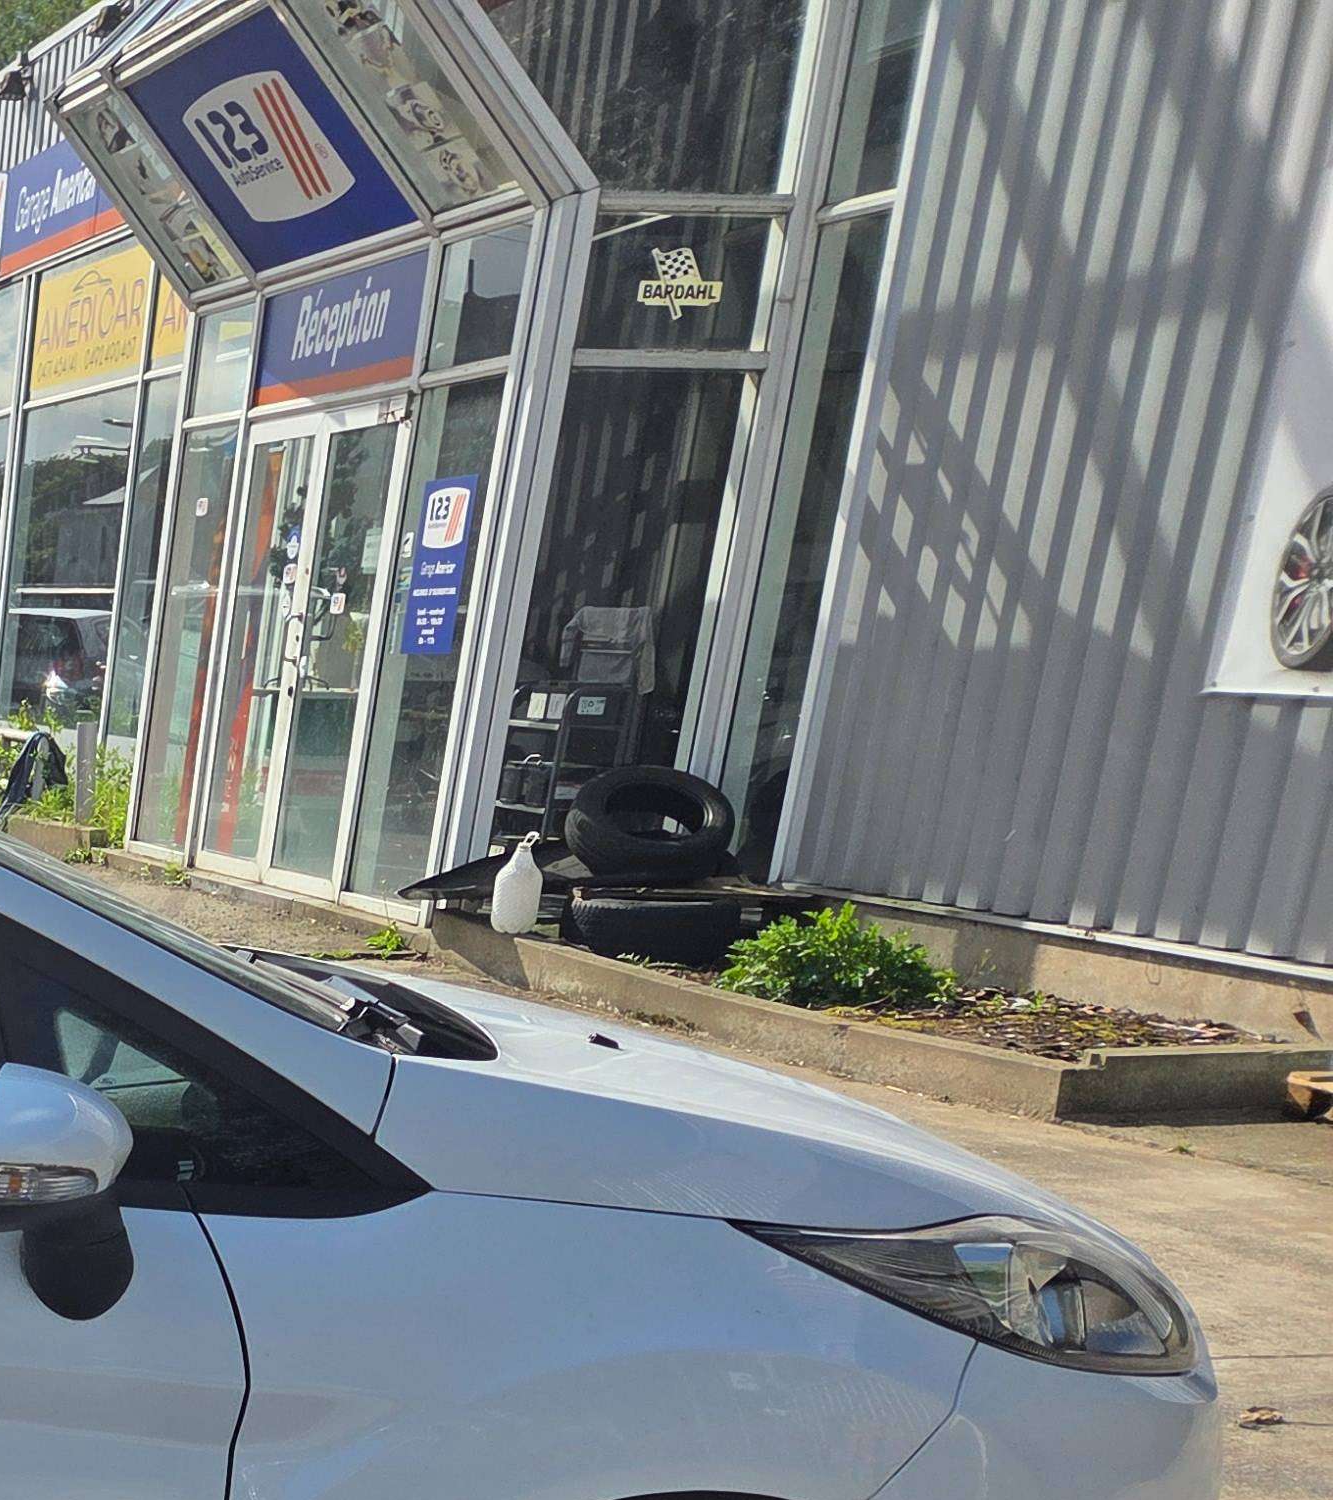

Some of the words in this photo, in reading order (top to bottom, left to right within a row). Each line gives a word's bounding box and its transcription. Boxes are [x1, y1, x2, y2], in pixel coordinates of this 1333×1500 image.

[194, 101, 269, 179] 123
[231, 157, 284, 187] AutoService
[15, 185, 51, 235] Garage
[37, 278, 146, 354] AMERICAR
[642, 284, 717, 300] BARDAHL
[291, 276, 391, 367] Réception
[429, 495, 451, 521] 123
